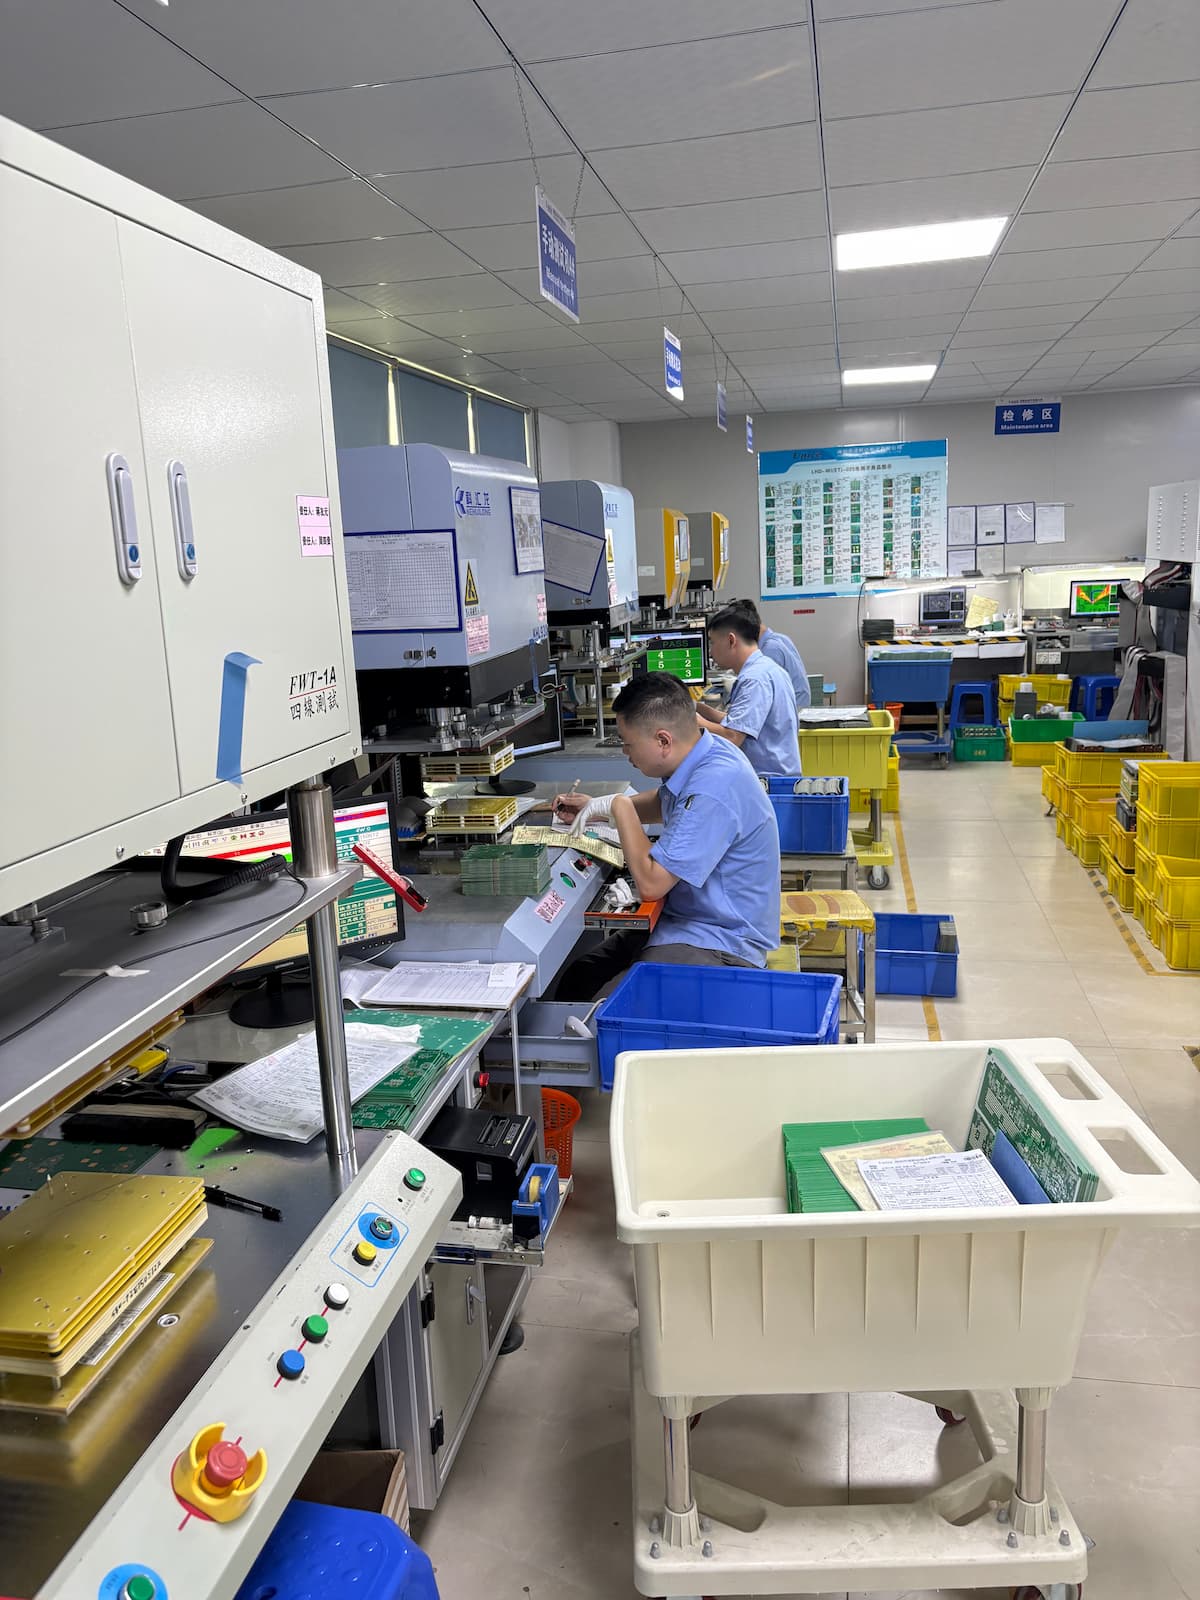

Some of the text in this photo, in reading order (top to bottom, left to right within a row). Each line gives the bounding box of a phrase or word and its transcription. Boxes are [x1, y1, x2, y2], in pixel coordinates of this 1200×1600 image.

[1002, 407, 1053, 422] 检修区
[662, 640, 689, 649] PASS
[658, 650, 690, 659] 4 1
[685, 659, 691, 668] 2
[289, 666, 337, 695] FWT-1A
[290, 689, 339, 720] 四線測試
